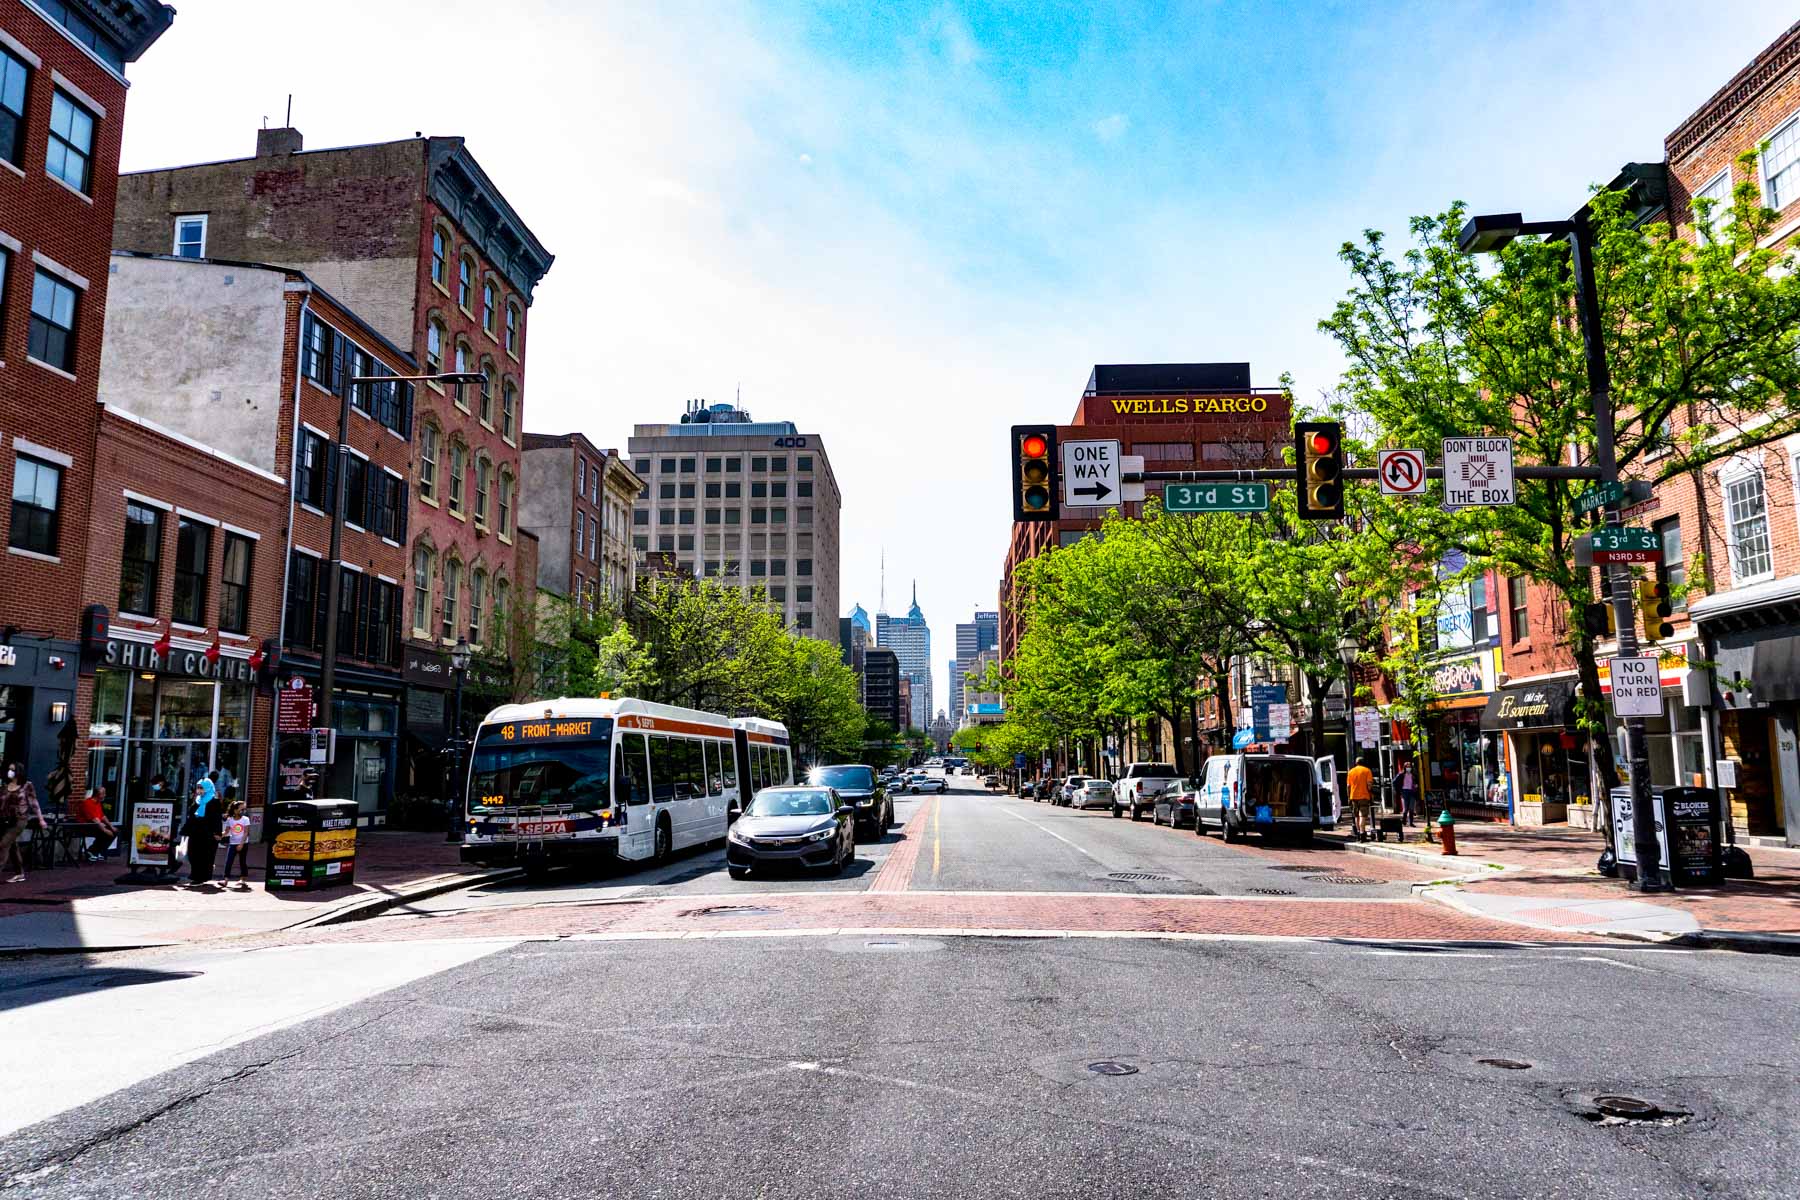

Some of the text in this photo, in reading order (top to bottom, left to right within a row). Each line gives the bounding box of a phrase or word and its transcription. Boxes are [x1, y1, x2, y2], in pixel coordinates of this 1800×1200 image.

[1111, 397, 1267, 414] WELLS FARGO
[774, 437, 806, 448] 400
[1476, 440, 1508, 452] BLOCK
[1074, 446, 1109, 461] ONE
[1074, 464, 1111, 478] WAY
[1178, 488, 1256, 504] 3rd St
[1450, 489, 1509, 503] THE BOX
[1581, 490, 1607, 512] MARKET
[1609, 535, 1658, 549] 3rd St
[1636, 552, 1646, 560] St
[1438, 613, 1462, 633] DIRECT
[105, 640, 259, 682] SHIRT CORNER
[1623, 662, 1645, 673] NO
[1619, 675, 1653, 685] TURN
[1616, 687, 1658, 697] ON RED
[1509, 700, 1549, 717] souvenir
[501, 721, 592, 740] 48 FRONT-MARKET
[482, 796, 504, 805] 5442
[526, 822, 567, 835] SEPTA
